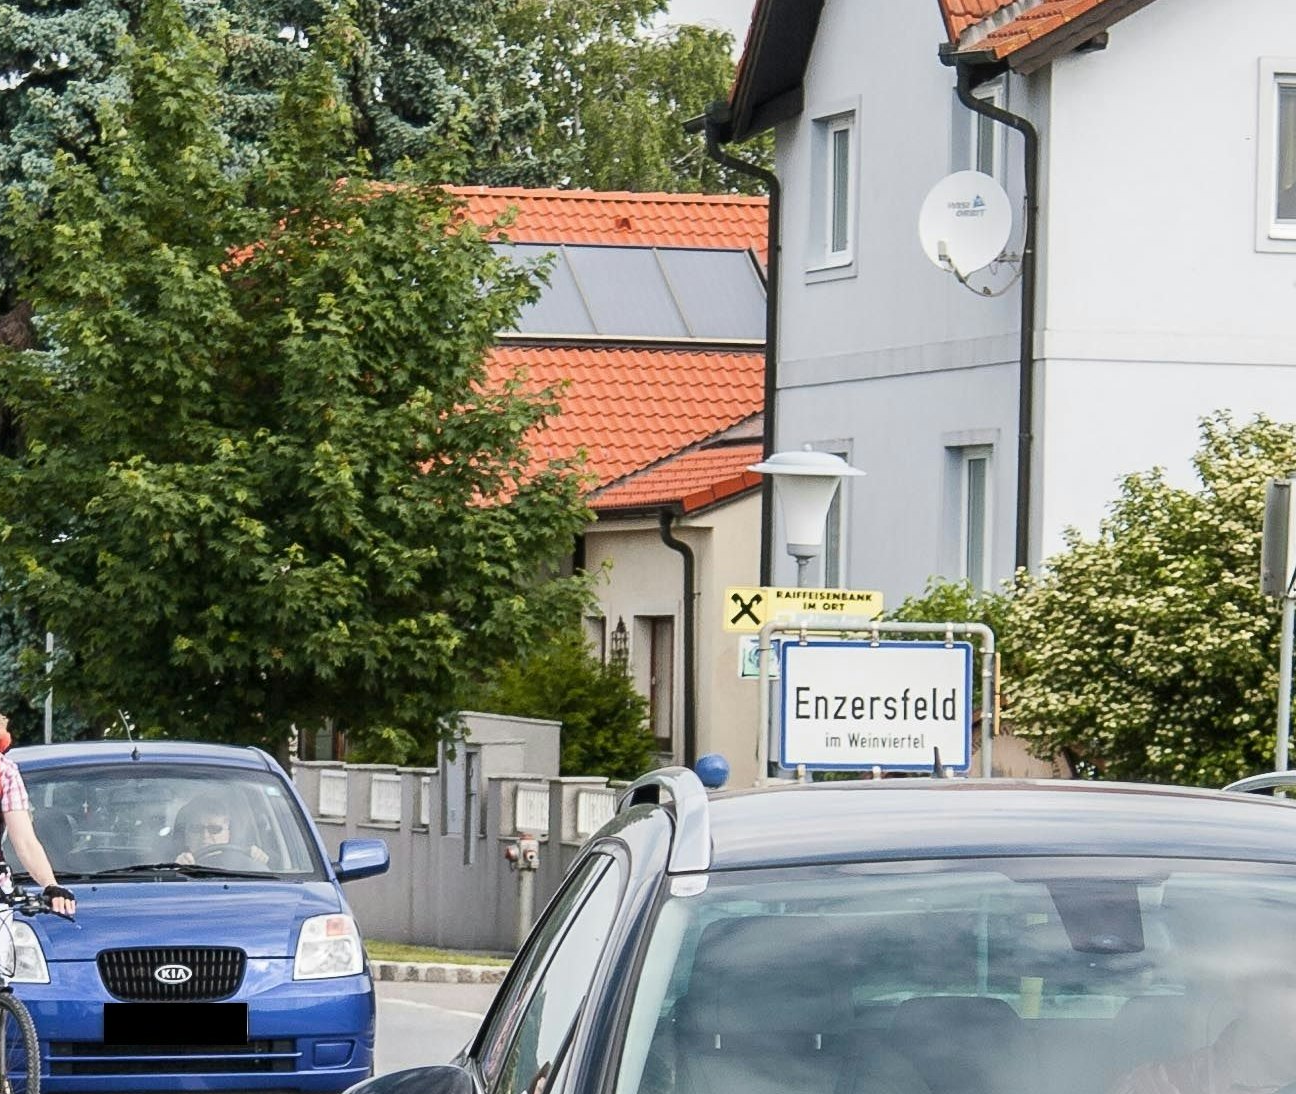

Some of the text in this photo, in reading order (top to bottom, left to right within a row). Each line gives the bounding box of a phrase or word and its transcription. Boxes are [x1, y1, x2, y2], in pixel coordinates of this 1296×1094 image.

[776, 590, 873, 602] RAIFFEISENBANK
[803, 602, 845, 611] IM ORT
[795, 686, 957, 721] Enzersfeld
[825, 732, 925, 749] im Weinviertel
[161, 967, 187, 979] KIA
